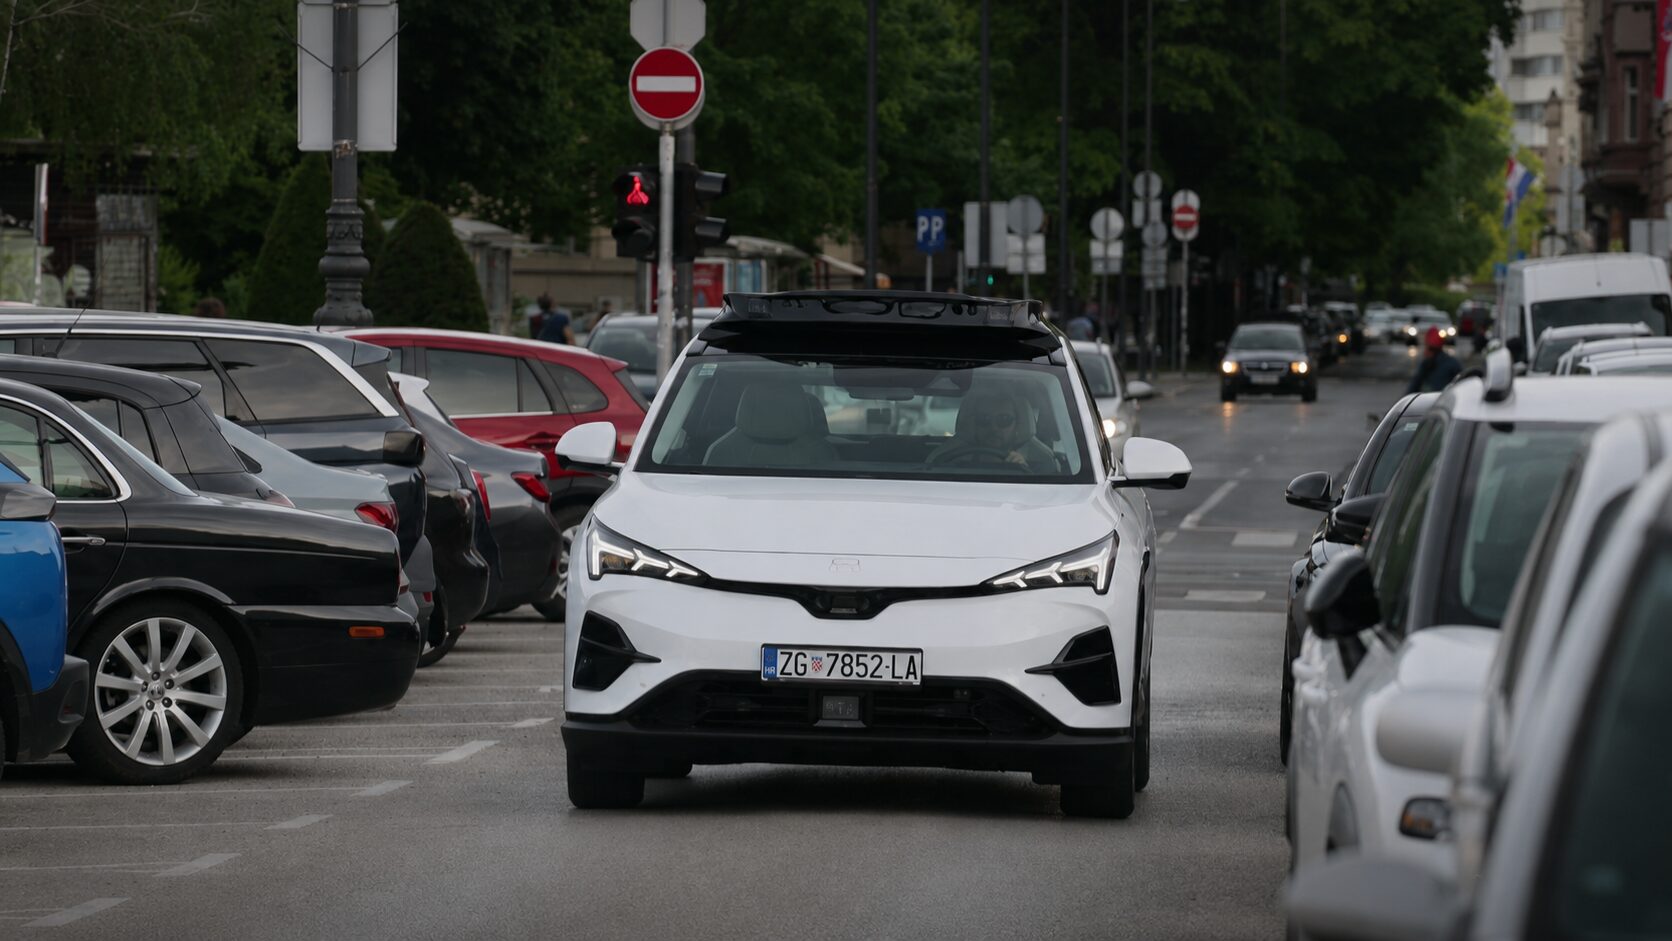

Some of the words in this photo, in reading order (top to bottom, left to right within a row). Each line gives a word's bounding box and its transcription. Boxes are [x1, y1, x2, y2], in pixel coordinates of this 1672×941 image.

[764, 666, 776, 675] HR
[780, 651, 807, 676] ZG
[826, 653, 918, 680] 7852-LA
